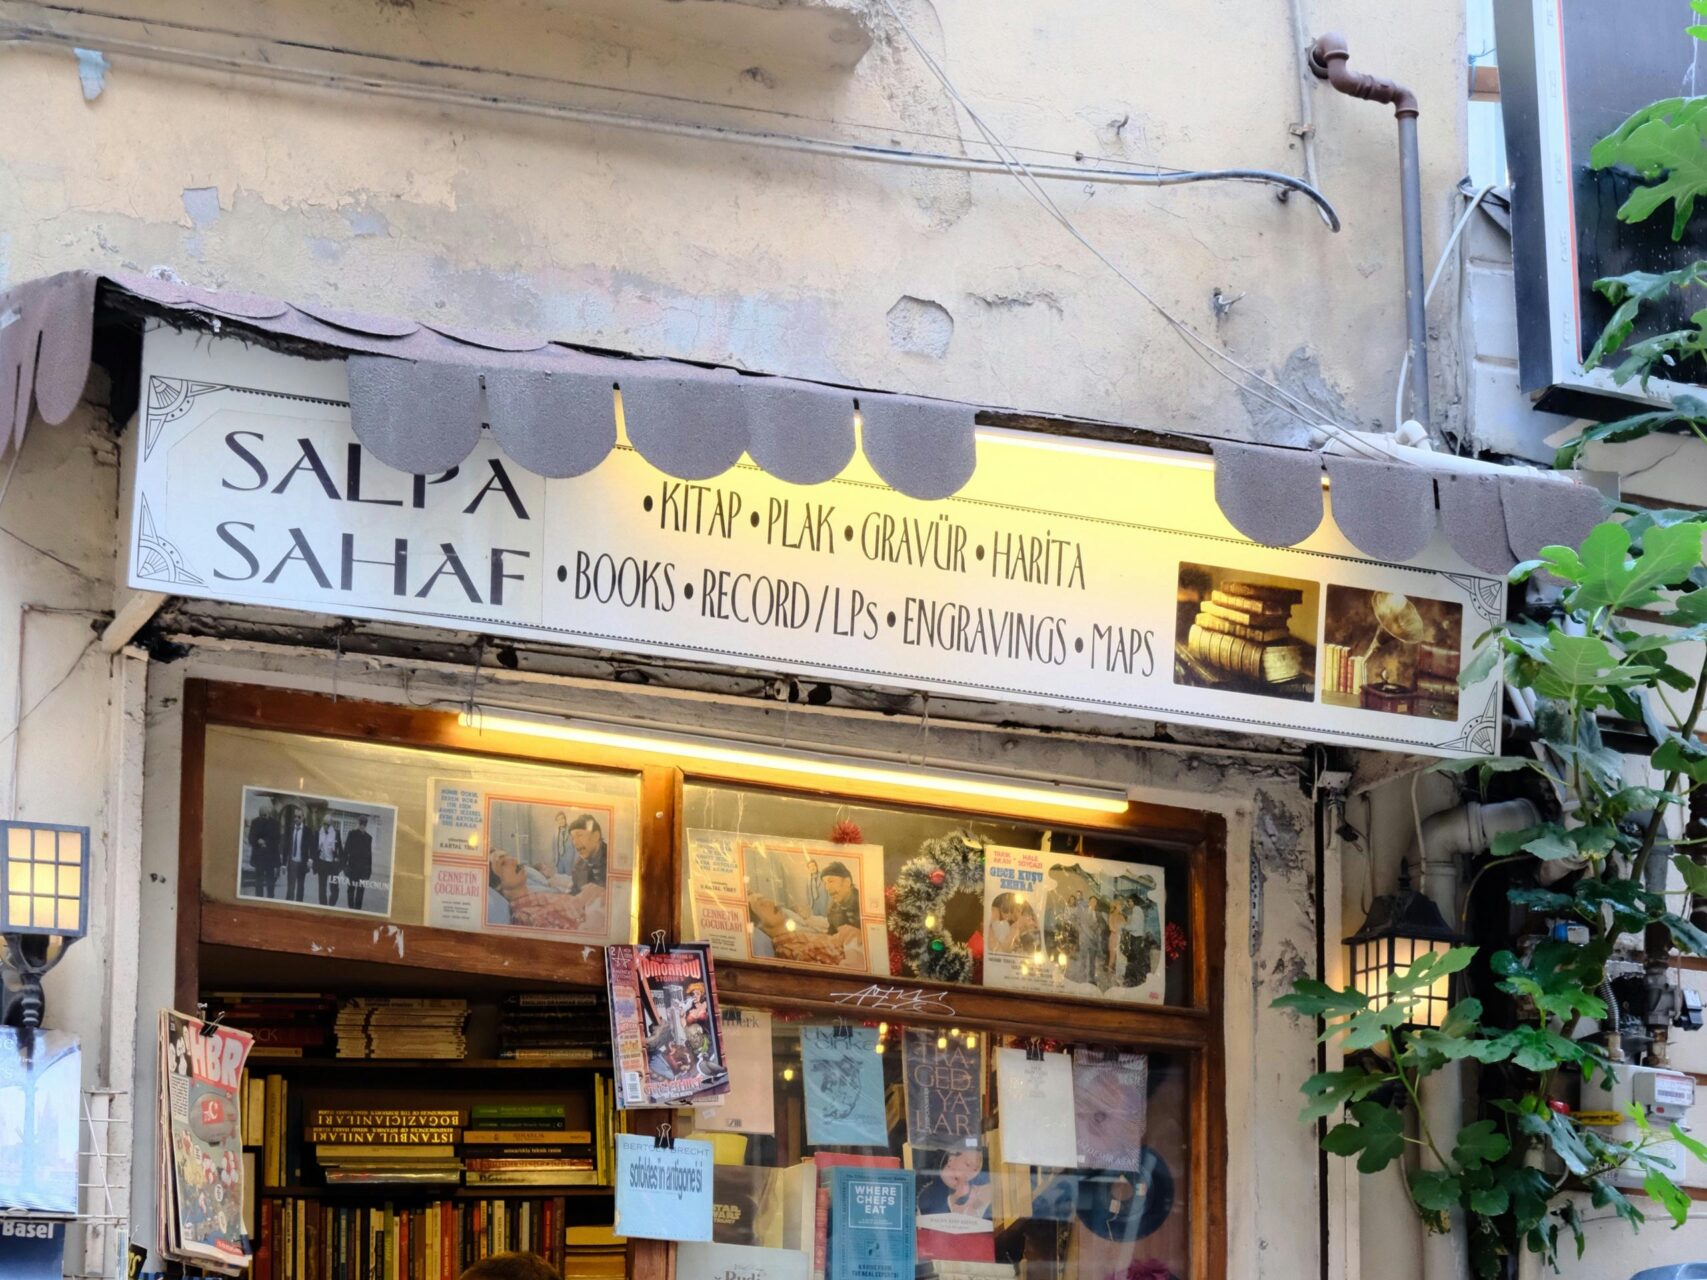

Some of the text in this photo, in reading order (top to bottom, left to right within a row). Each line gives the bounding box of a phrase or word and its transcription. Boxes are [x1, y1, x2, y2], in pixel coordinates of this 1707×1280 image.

[767, 496, 837, 555] PLAK
[860, 510, 968, 573] GRAVÜR
[991, 528, 1086, 591] HARİTA
[212, 520, 532, 606] SAHAF
[574, 551, 677, 613] BOOKS
[902, 596, 1068, 666] ENGRAVINGS
[1090, 625, 1155, 678] MAPS
[855, 1185, 896, 1196] WHERE
[856, 1195, 895, 1206] CHEFS
[865, 1205, 886, 1215] EAT
[2, 1221, 55, 1239] Basel
